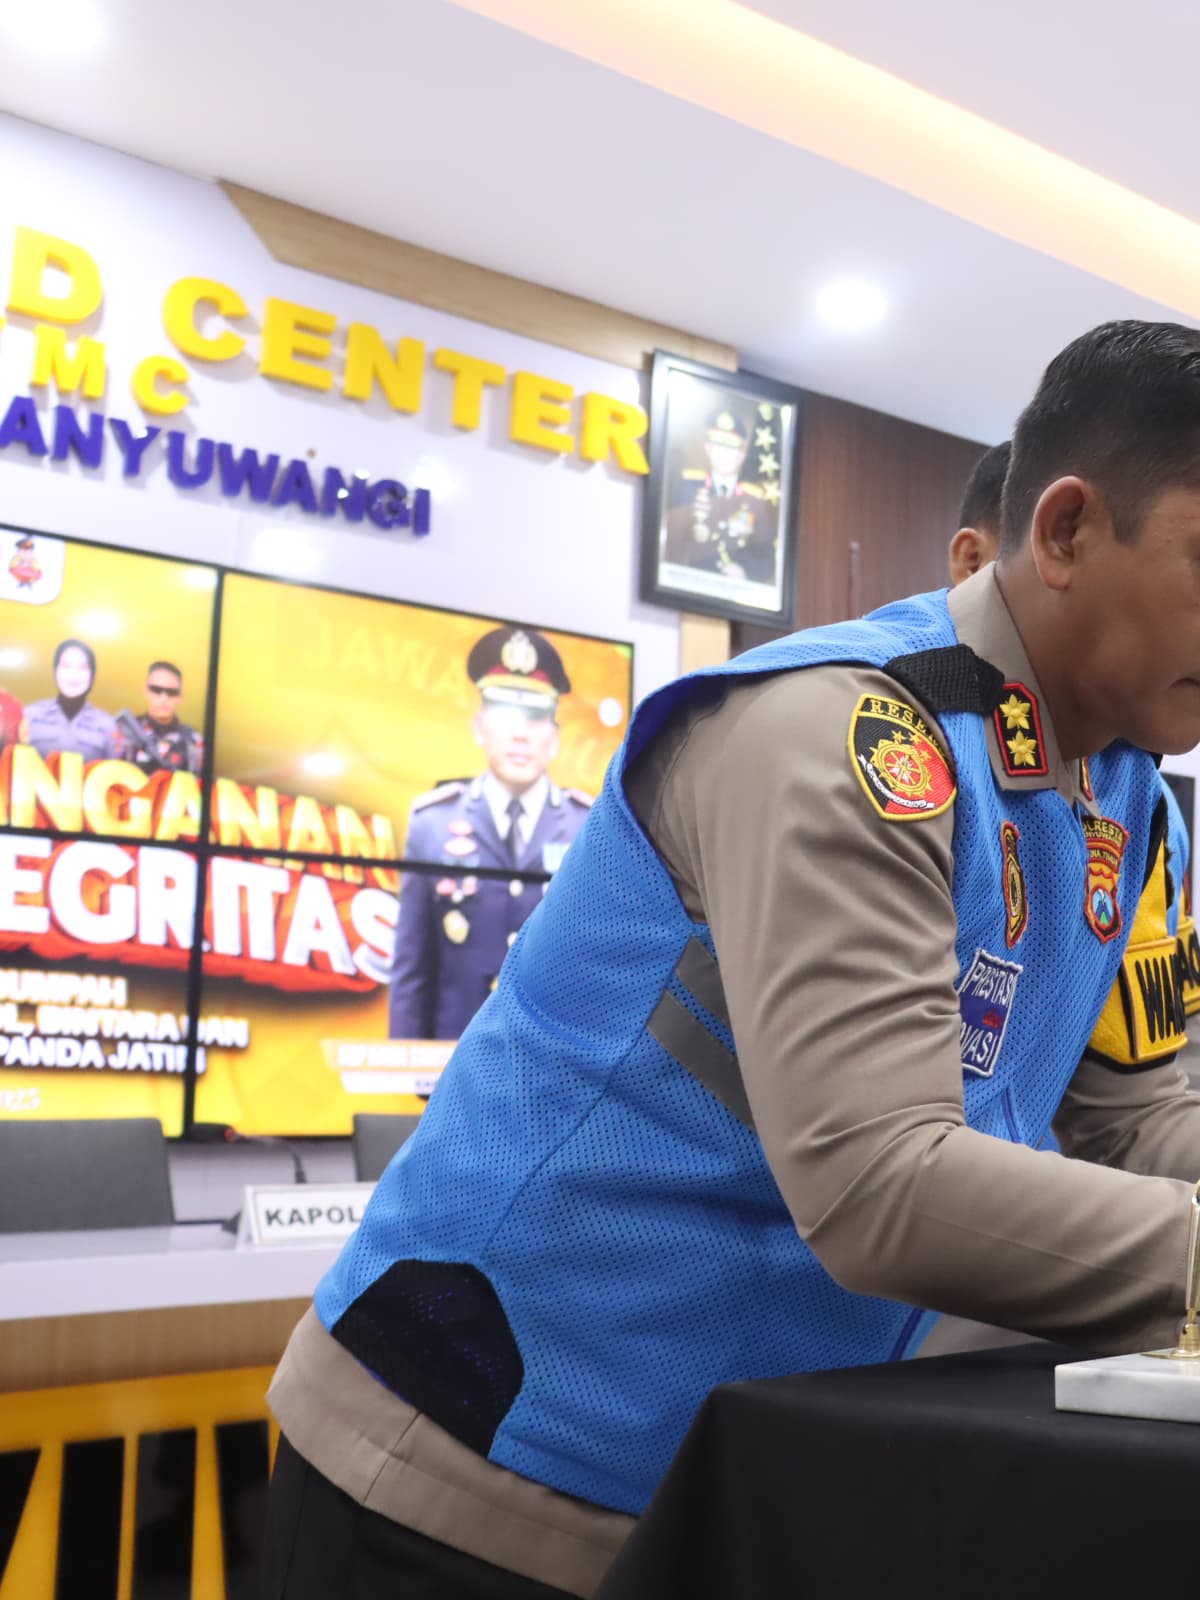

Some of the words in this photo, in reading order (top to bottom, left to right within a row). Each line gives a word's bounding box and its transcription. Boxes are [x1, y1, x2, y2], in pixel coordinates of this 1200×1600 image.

[0, 316, 190, 416] MC
[162, 275, 650, 476] CENTER
[0, 395, 431, 537] ANYUWANGI
[0, 743, 400, 893] NGANAN
[960, 1021, 999, 1068] OVASI
[963, 961, 1018, 1009] PRESTASI
